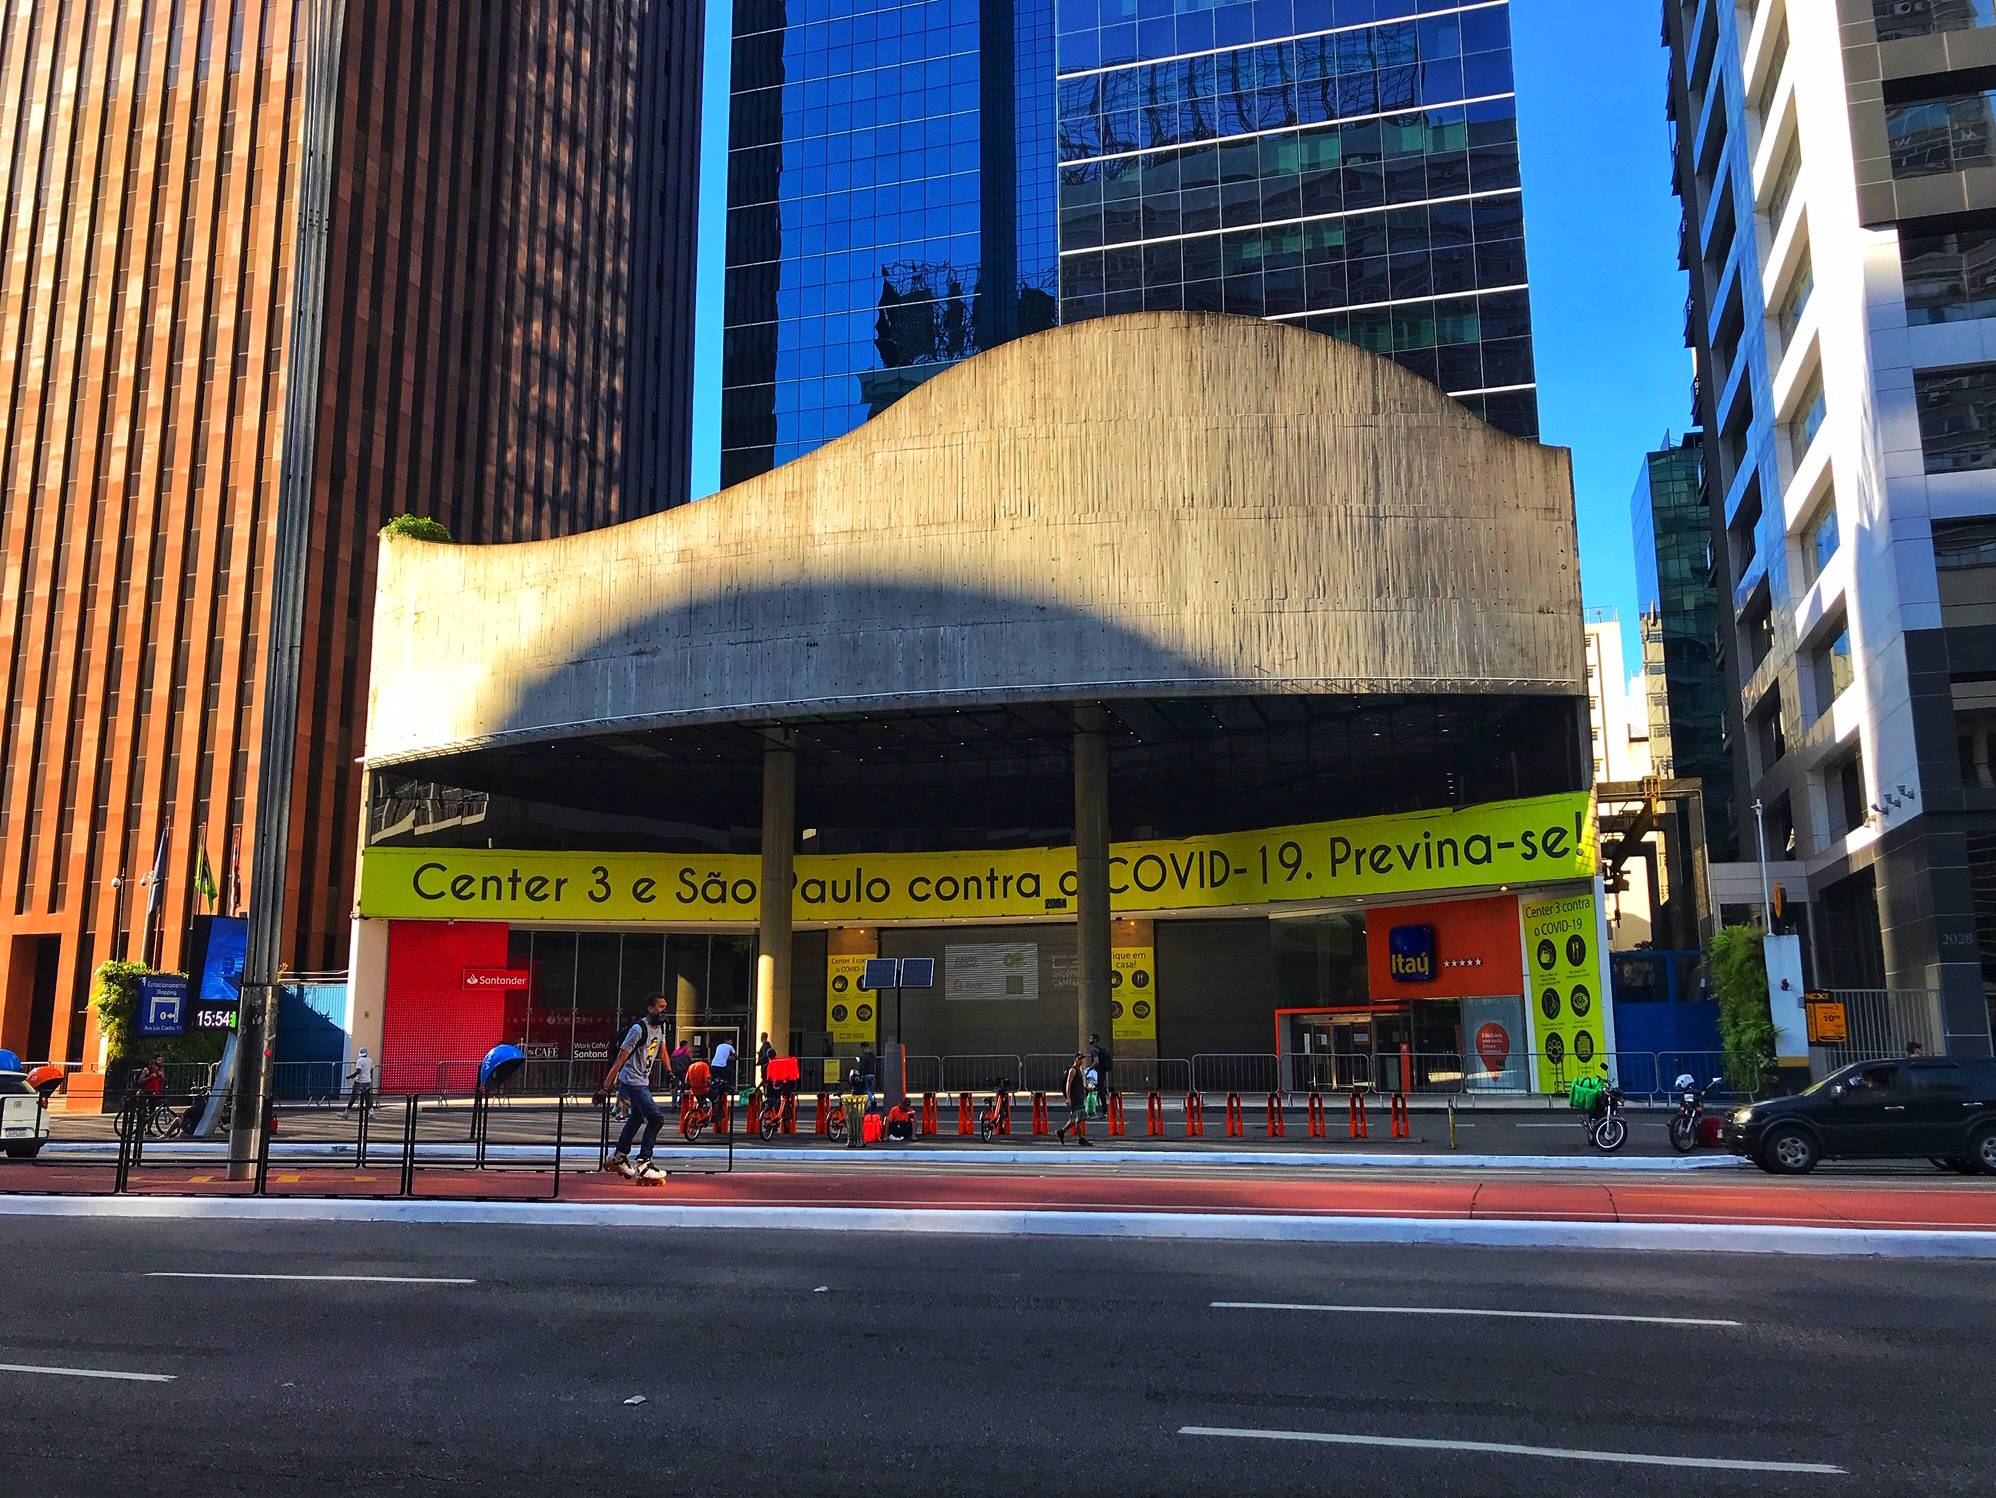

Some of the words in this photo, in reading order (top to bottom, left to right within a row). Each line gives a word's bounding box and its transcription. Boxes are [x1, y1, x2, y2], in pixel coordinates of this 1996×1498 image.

[413, 862, 568, 901] Center
[588, 866, 612, 903] 3
[632, 877, 657, 904] e
[675, 867, 757, 904] São
[791, 867, 891, 904] aulo
[908, 867, 1041, 902] contra
[1109, 841, 1313, 894] COVID-19.
[1330, 811, 1583, 877] Previna-se!
[1525, 905, 1553, 918] Center
[1555, 902, 1560, 913] 3
[1562, 898, 1590, 912] contra
[1533, 927, 1540, 936] o
[1541, 917, 1583, 935] COVID-19
[1941, 933, 1973, 944] 2028
[1115, 960, 1137, 969] casa!
[1132, 952, 1146, 960] em
[1391, 952, 1429, 974] Itaú
[479, 975, 527, 985] Santander
[197, 1010, 230, 1027] 15:54
